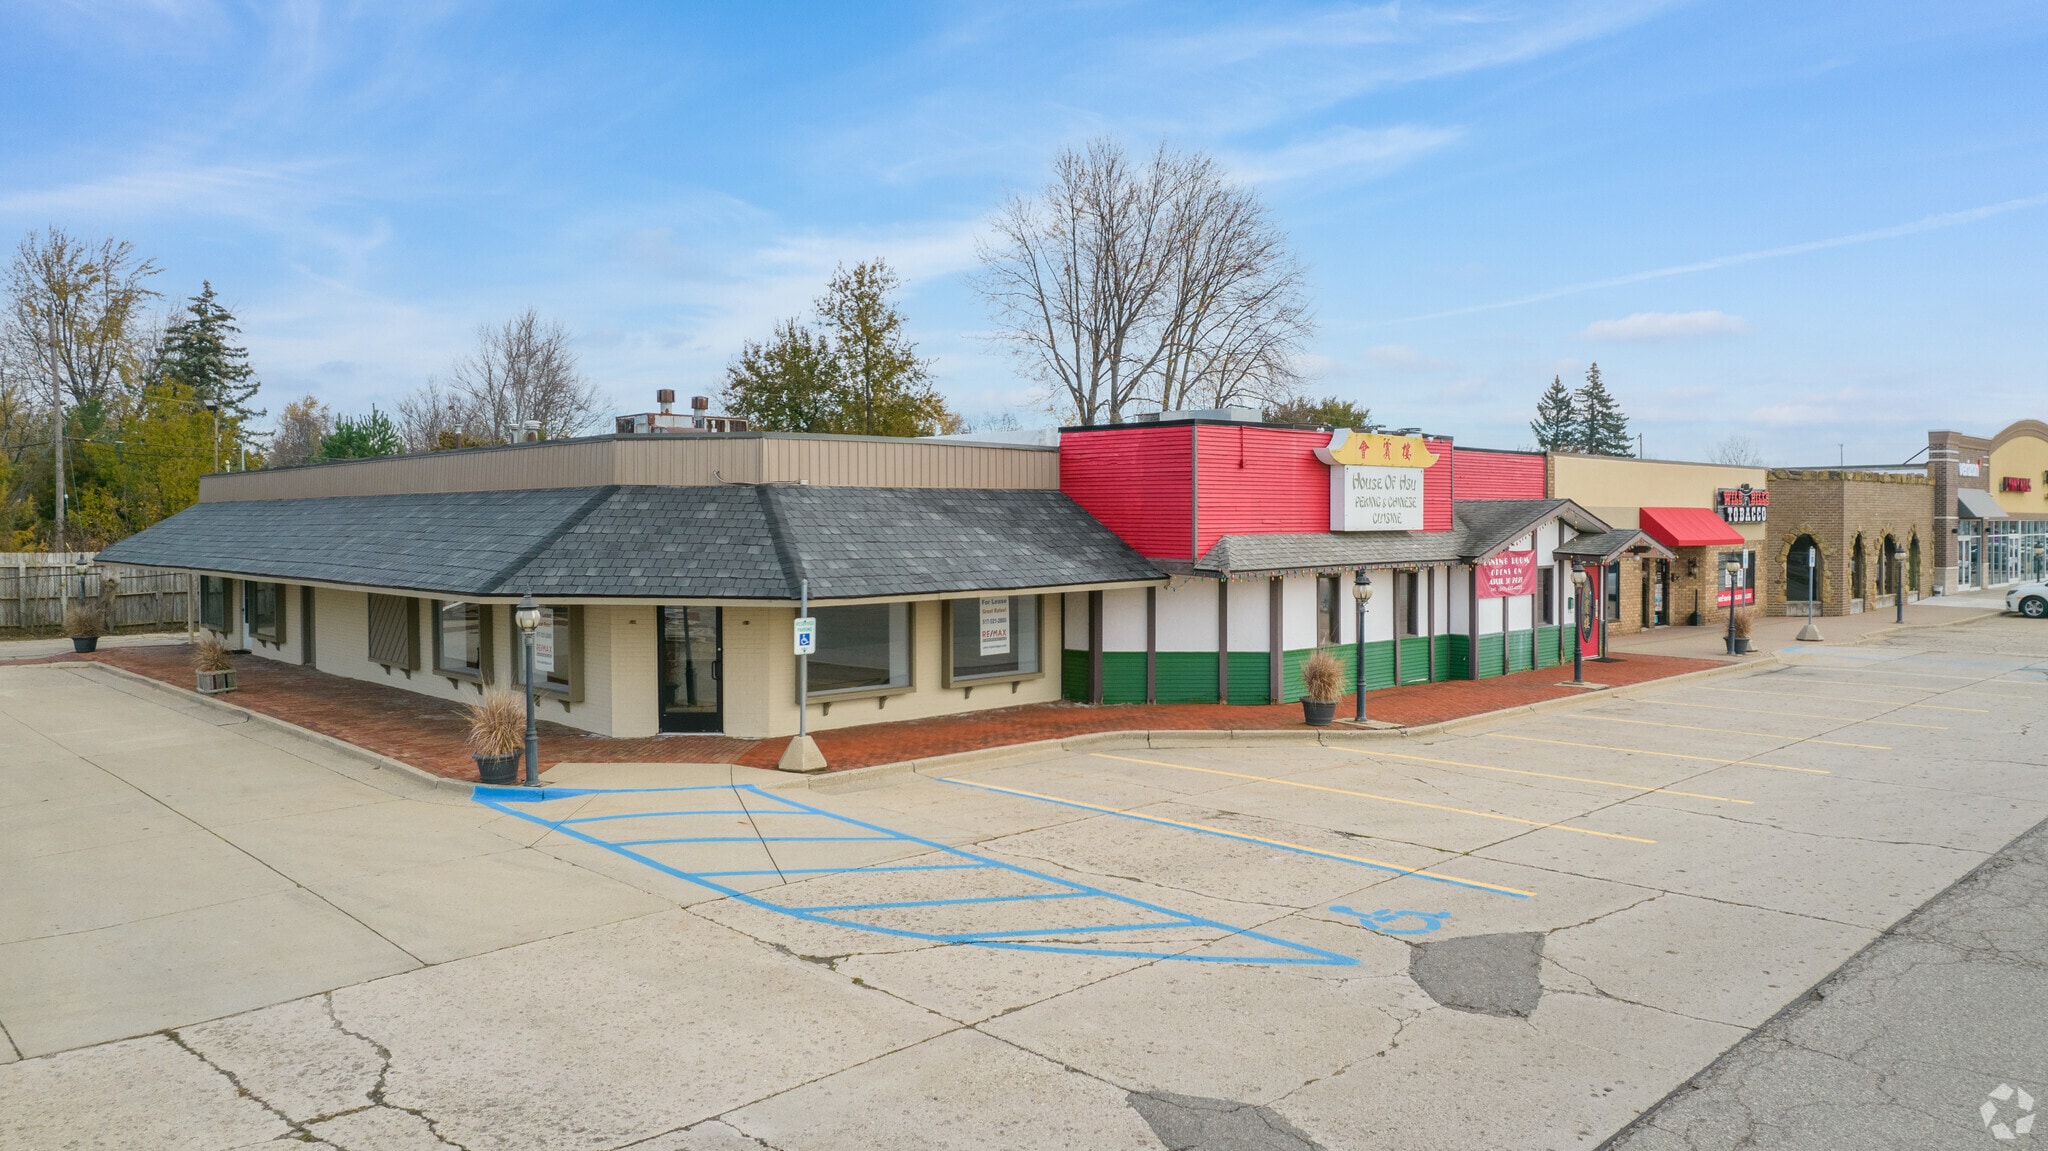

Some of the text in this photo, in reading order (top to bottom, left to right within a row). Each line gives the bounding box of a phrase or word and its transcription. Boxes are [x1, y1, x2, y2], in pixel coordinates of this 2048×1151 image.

[1355, 496, 1417, 508] PEKING & CHINESE
[1372, 512, 1402, 524] CUISINE
[1728, 507, 1767, 521] TOBACCO
[1491, 568, 1511, 576] OPENS
[982, 629, 1006, 637] RE/MAX
